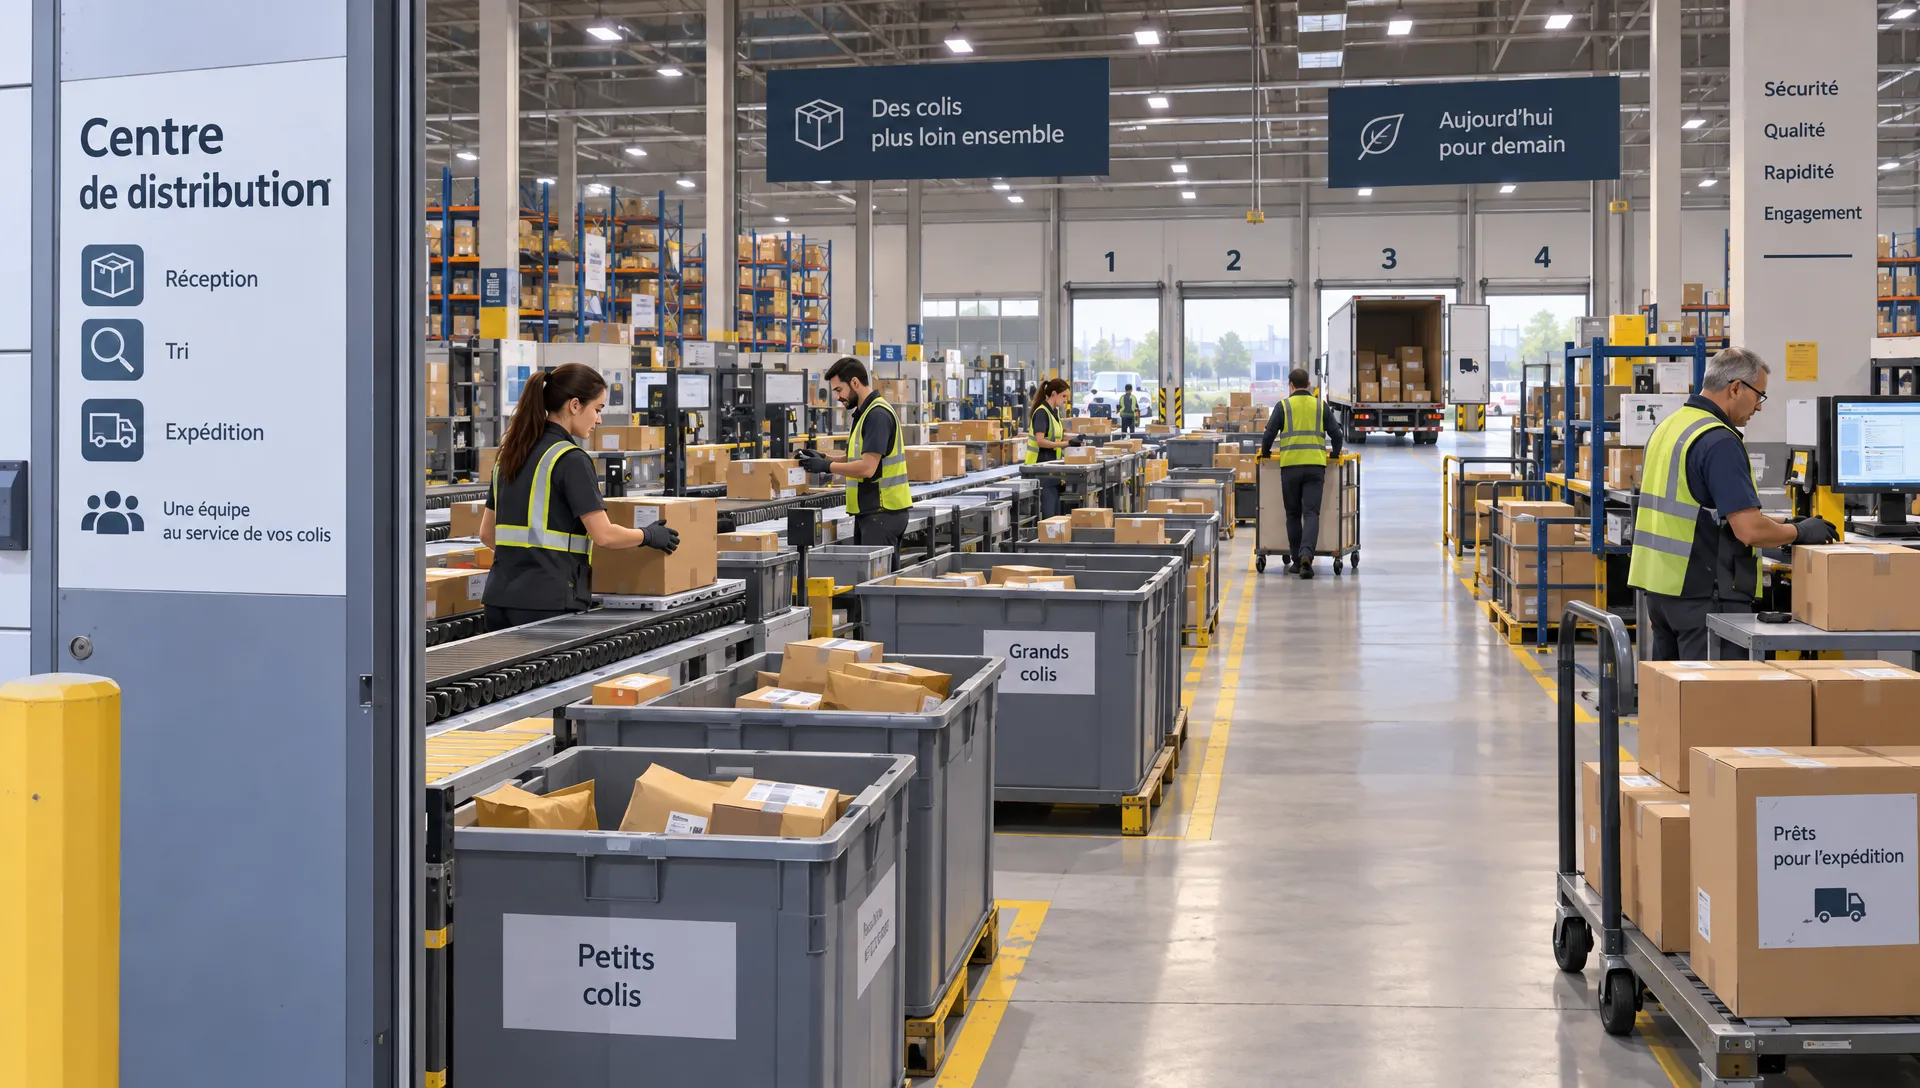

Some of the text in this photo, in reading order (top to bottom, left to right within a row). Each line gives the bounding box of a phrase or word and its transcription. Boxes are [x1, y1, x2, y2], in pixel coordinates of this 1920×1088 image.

[1765, 80, 1838, 96] Sécurité
[873, 97, 962, 117] Des colis
[1439, 108, 1552, 134] Aujourd’hui
[1765, 122, 1825, 140] Qualité
[81, 118, 223, 157] Centre
[872, 124, 1064, 151] plus loin ensemble
[1440, 135, 1565, 161] pour demain
[1765, 164, 1834, 183] Rapidité
[80, 170, 330, 210] de distribution
[1765, 206, 1862, 224] Engagement
[1105, 252, 1114, 272] 1
[1227, 250, 1241, 271] 2
[1382, 248, 1397, 269] 3
[1535, 246, 1551, 268] 4
[167, 270, 257, 291] Réception
[166, 342, 188, 359] Tri
[167, 423, 263, 445] Expédition
[164, 501, 250, 520] Une équipe
[164, 526, 331, 542] au service de vos colis
[1010, 644, 1068, 659] Grands
[1021, 666, 1056, 681] colis
[1775, 825, 1816, 841] Prêts
[1775, 848, 1903, 870] pour l’expédition
[579, 944, 654, 970] Petits
[583, 982, 641, 1007] colis
